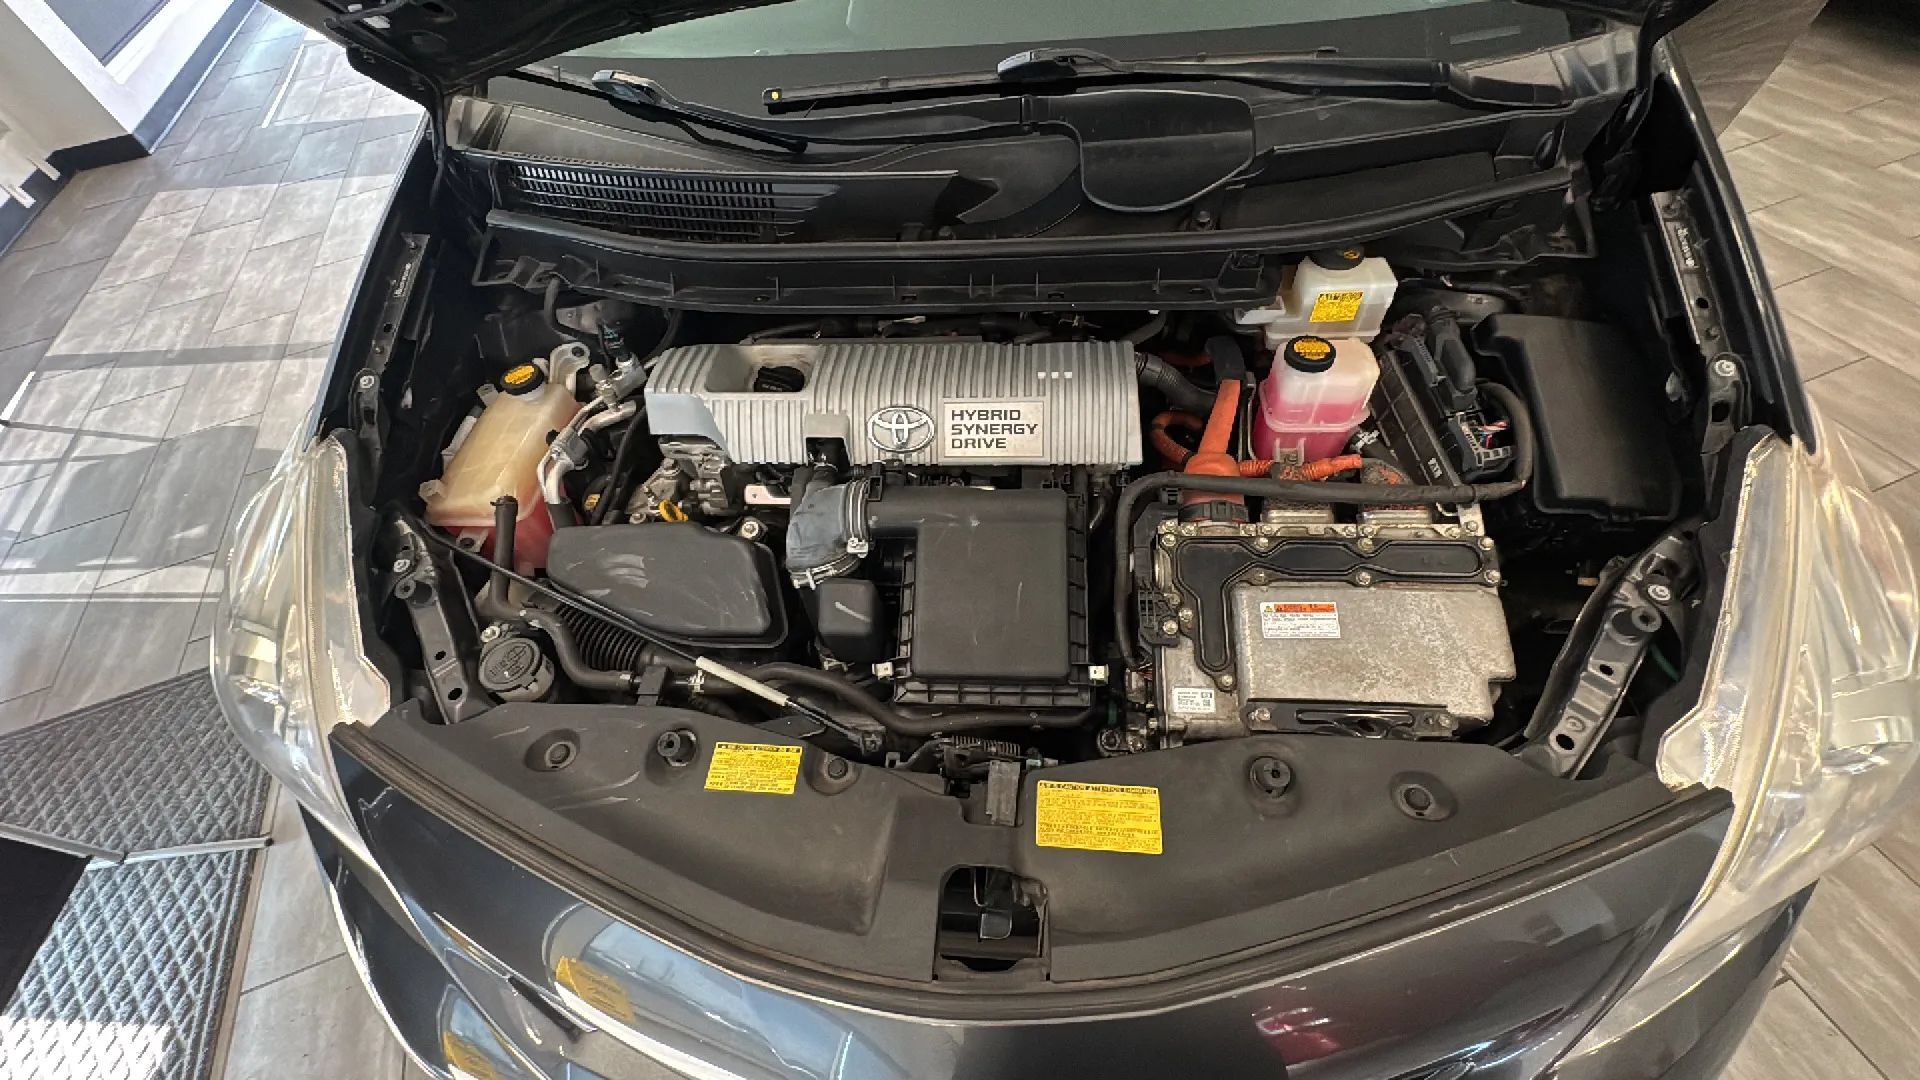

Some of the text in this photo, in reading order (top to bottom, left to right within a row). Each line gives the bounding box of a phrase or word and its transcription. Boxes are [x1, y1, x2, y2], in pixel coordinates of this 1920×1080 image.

[951, 410, 1020, 420] HYBRID
[951, 424, 1038, 435] SYNERGY
[951, 438, 1006, 448] DRIVE
